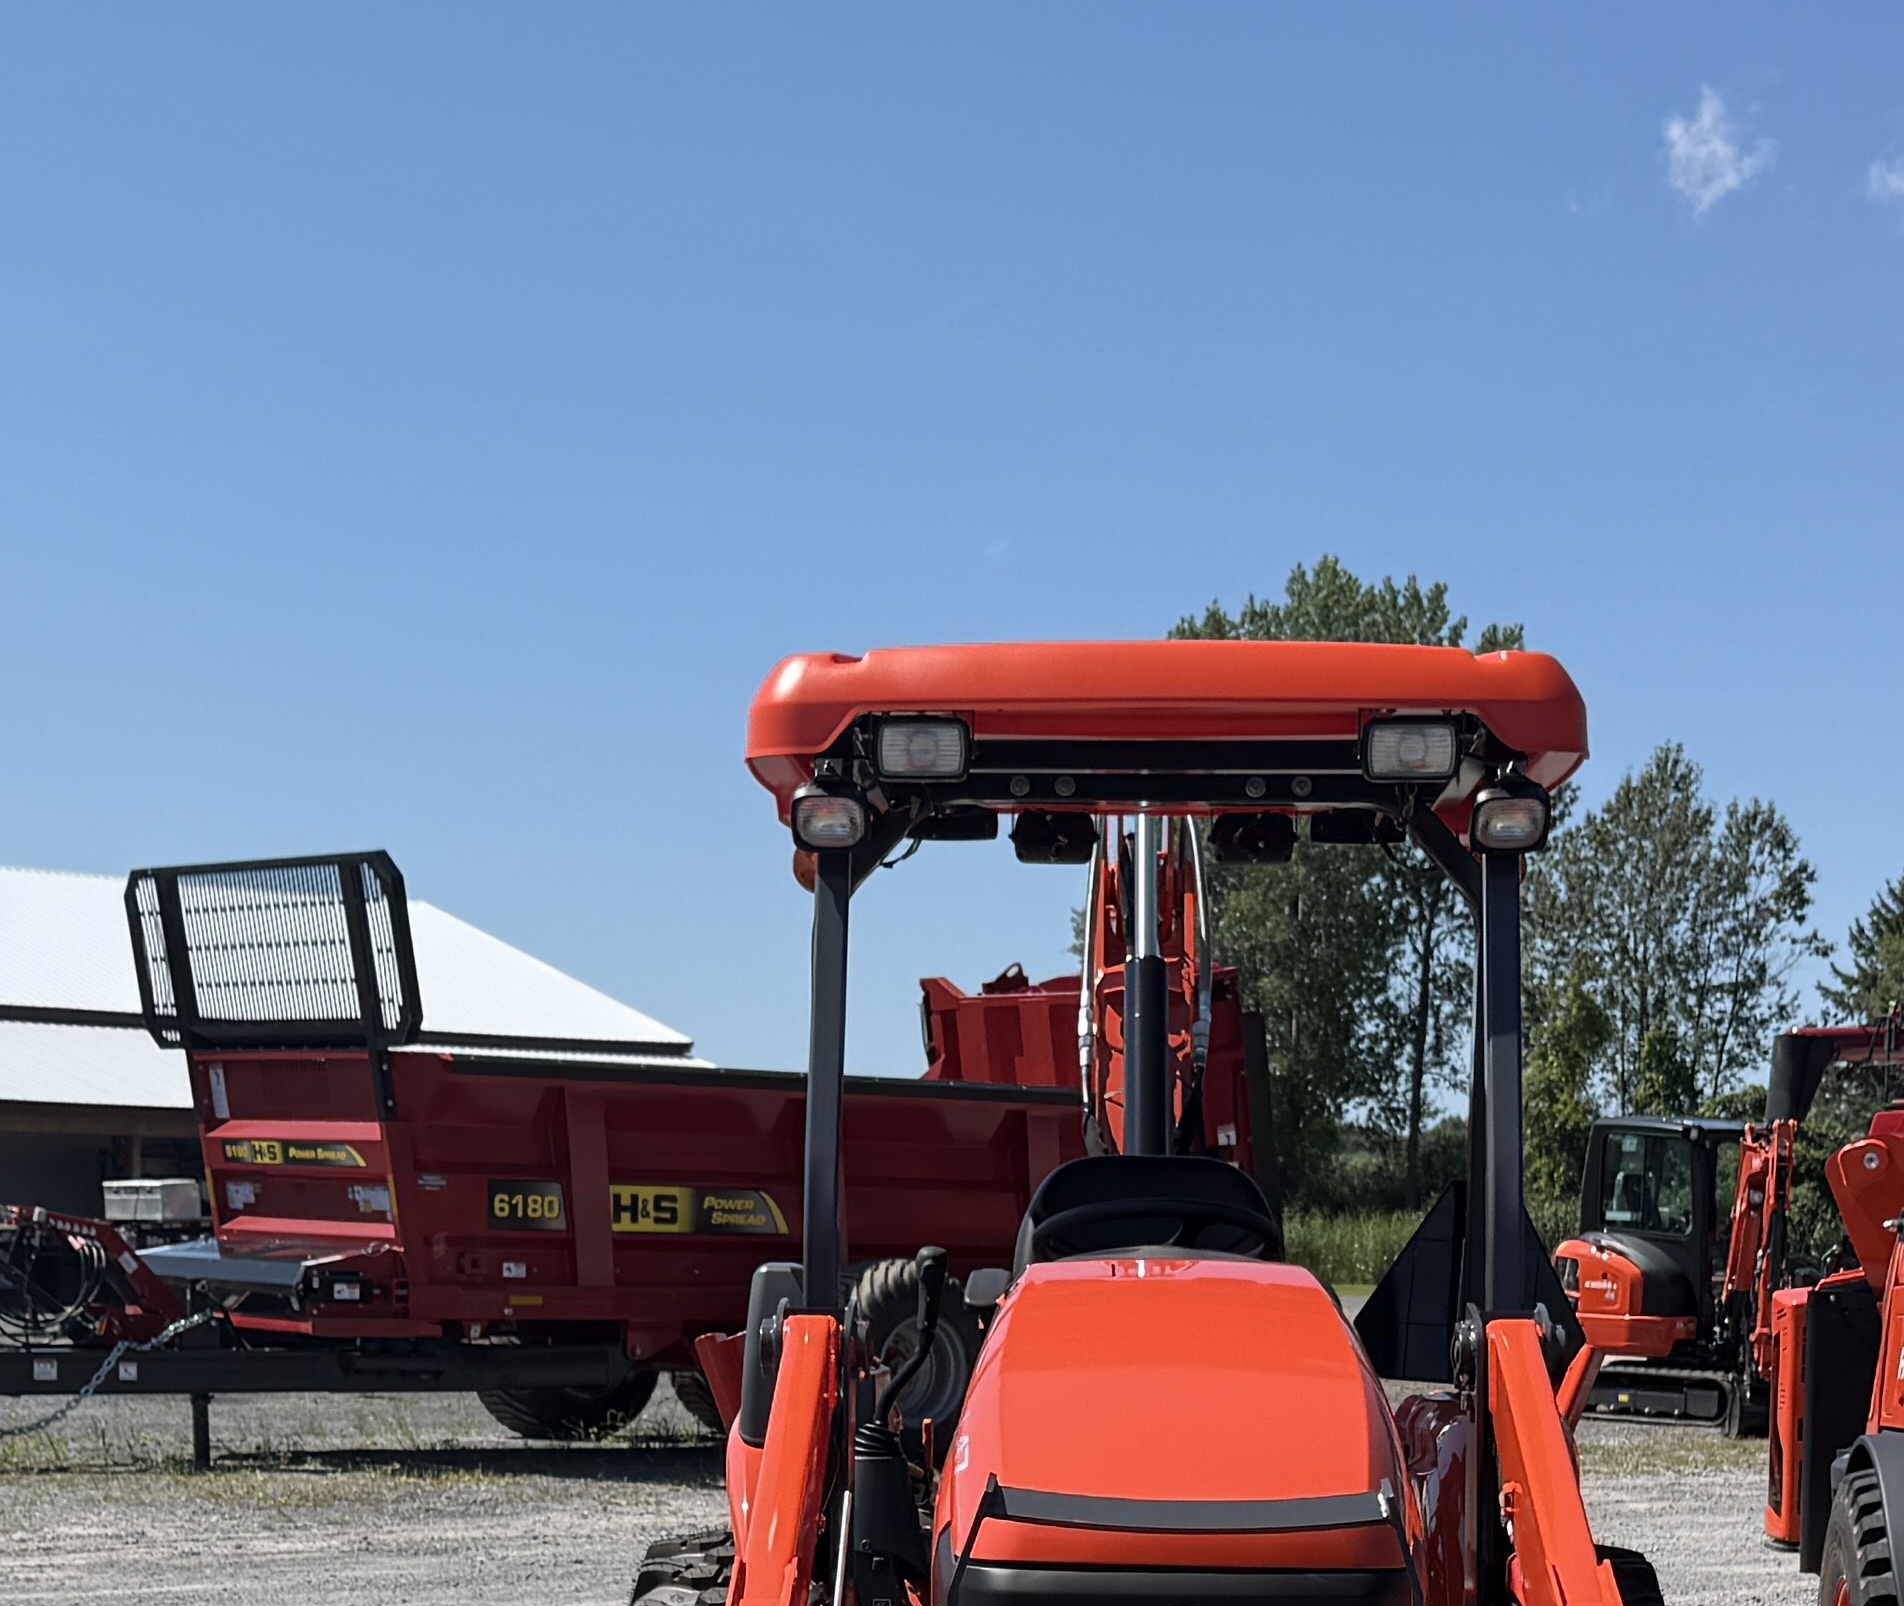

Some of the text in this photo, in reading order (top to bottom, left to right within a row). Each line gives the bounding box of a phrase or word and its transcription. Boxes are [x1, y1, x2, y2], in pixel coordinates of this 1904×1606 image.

[492, 1193, 561, 1220] 6180
[611, 1193, 680, 1225] H&S
[703, 1196, 755, 1211] POWER
[711, 1210, 767, 1226] SPREAD
